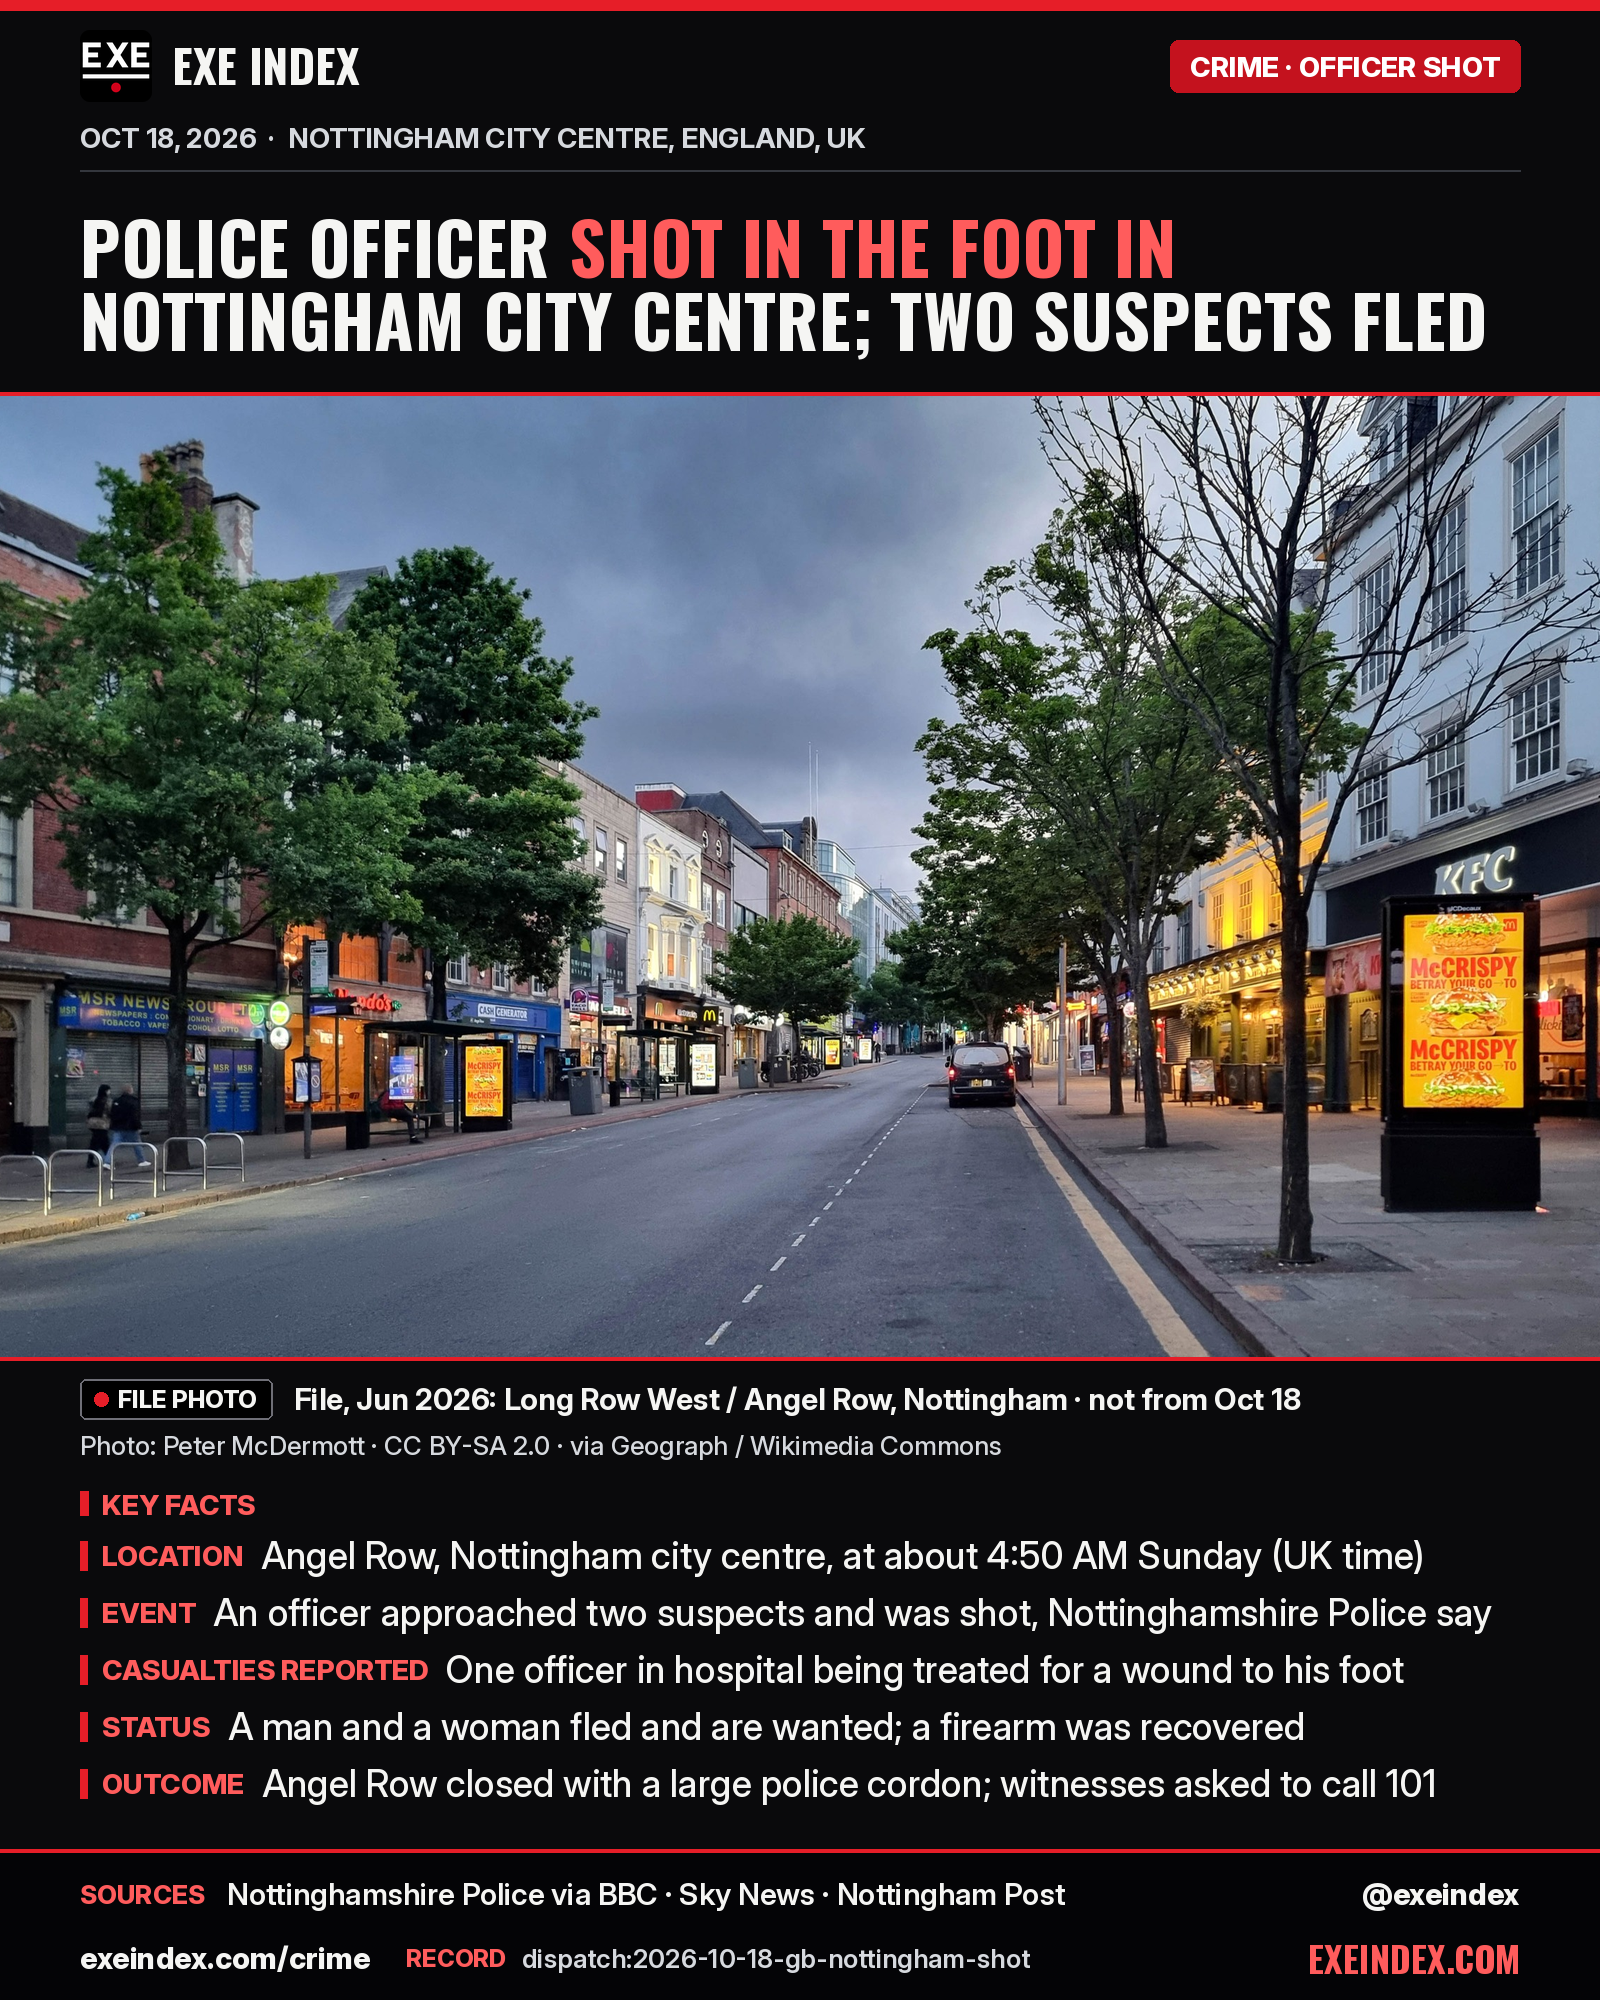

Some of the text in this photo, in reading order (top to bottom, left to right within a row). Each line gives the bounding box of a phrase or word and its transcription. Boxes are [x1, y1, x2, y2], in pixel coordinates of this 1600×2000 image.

[1434, 845, 1516, 896] KFC
[1410, 956, 1518, 979] McCRISPY
[1410, 978, 1517, 990] BETRAY YOUR GO TO
[78, 990, 117, 1006] MSR
[123, 993, 170, 1011] NEWS
[187, 999, 227, 1014] ROUP
[60, 1006, 77, 1015] MSR
[479, 1005, 495, 1017] CASH
[496, 1007, 528, 1020] GENERATOR
[102, 1018, 141, 1028] TOBACCO
[217, 1026, 239, 1034] LOTTO
[1410, 1039, 1518, 1061] McCRISPY
[213, 1063, 253, 1073] MSR MSR
[467, 1061, 502, 1070] McCRISPY
[1410, 1060, 1517, 1071] BETRAY YOUR GO TO
[467, 1091, 502, 1100] McCRISPY
